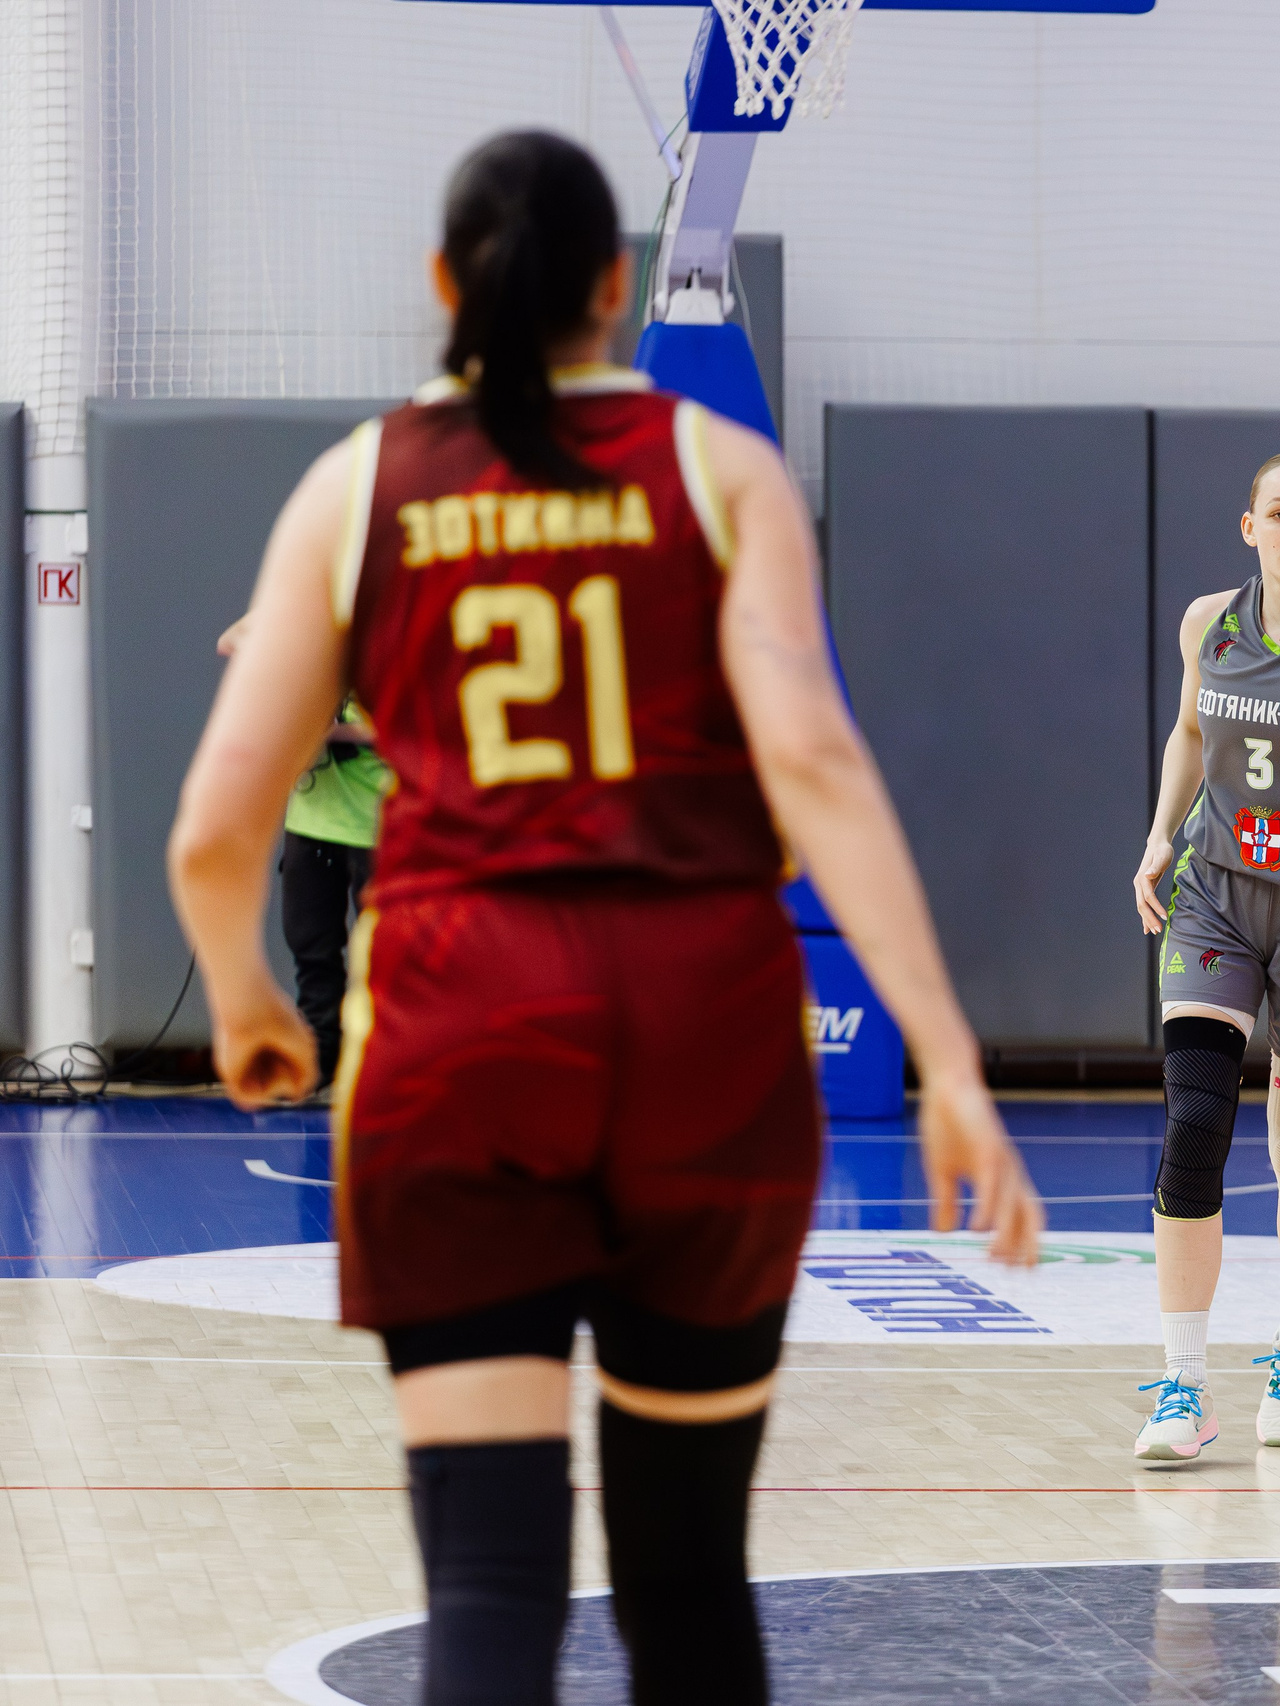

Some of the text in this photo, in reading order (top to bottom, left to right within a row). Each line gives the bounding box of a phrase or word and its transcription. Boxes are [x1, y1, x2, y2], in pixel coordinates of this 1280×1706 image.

[397, 483, 656, 567] ЗОТКИНА
[43, 569, 74, 599] ПК
[451, 574, 636, 788] 21
[1243, 737, 1274, 790] 3
[1167, 964, 1187, 974] PEAK
